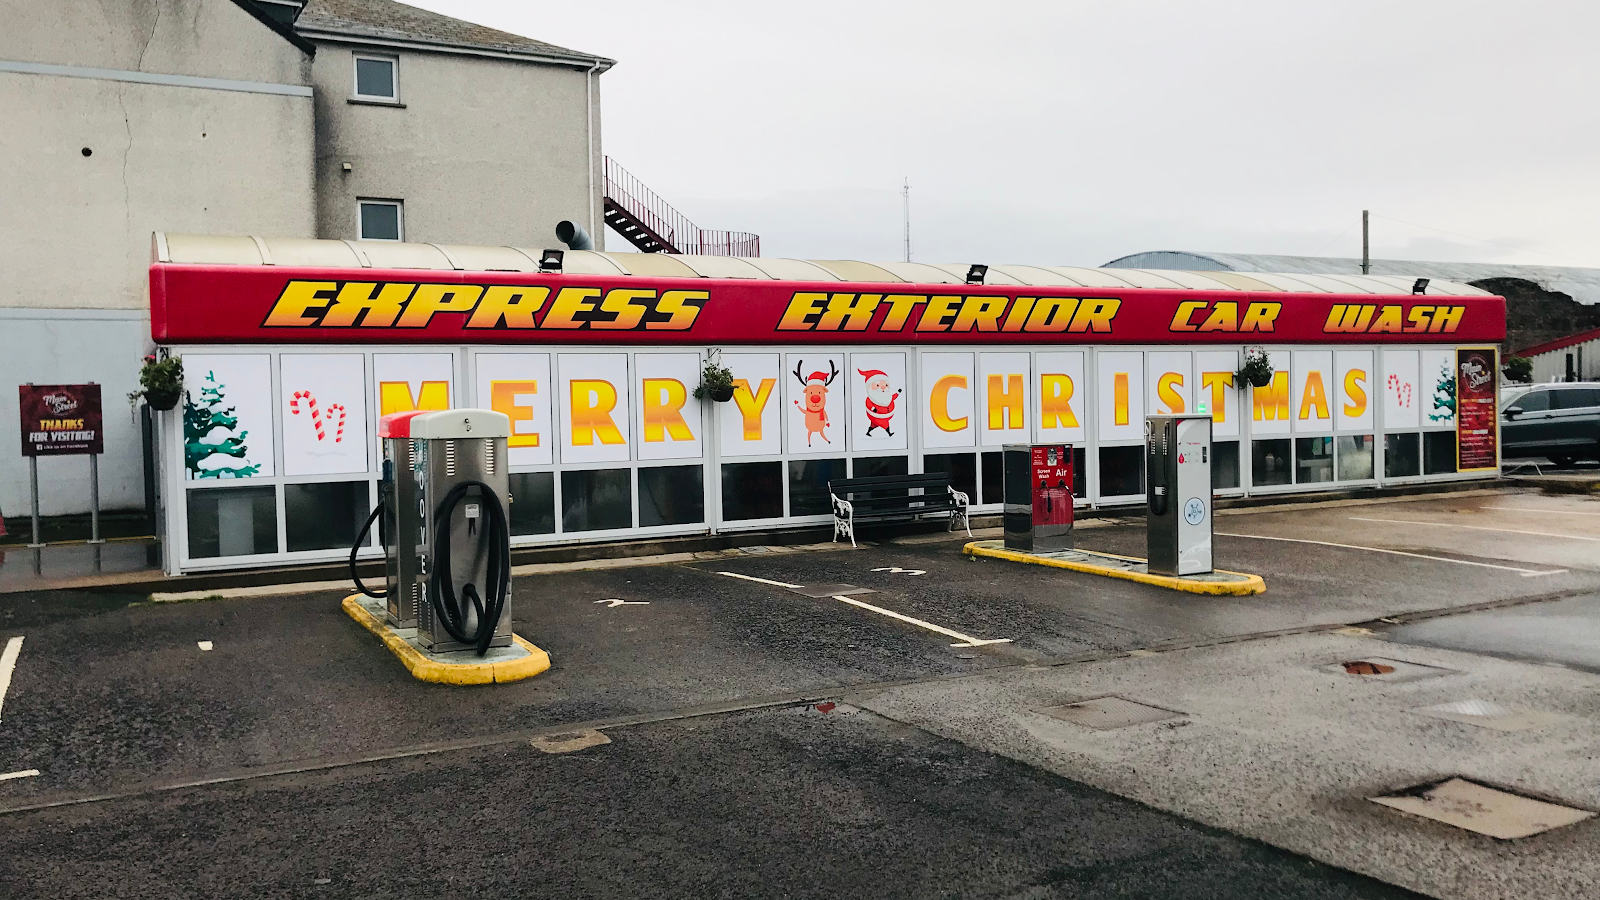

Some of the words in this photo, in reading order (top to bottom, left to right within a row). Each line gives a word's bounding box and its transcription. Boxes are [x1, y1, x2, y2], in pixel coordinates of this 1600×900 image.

[260, 279, 711, 332] EXPRESS
[774, 290, 1122, 334] EXTERIOR
[1168, 300, 1283, 334] CAR
[1322, 303, 1467, 335] WASH
[1470, 371, 1491, 388] Street
[929, 368, 1369, 433] CHRISTMAS
[39, 418, 85, 431] THANKS
[29, 432, 48, 443] FOR
[50, 430, 95, 442] VISITING!
